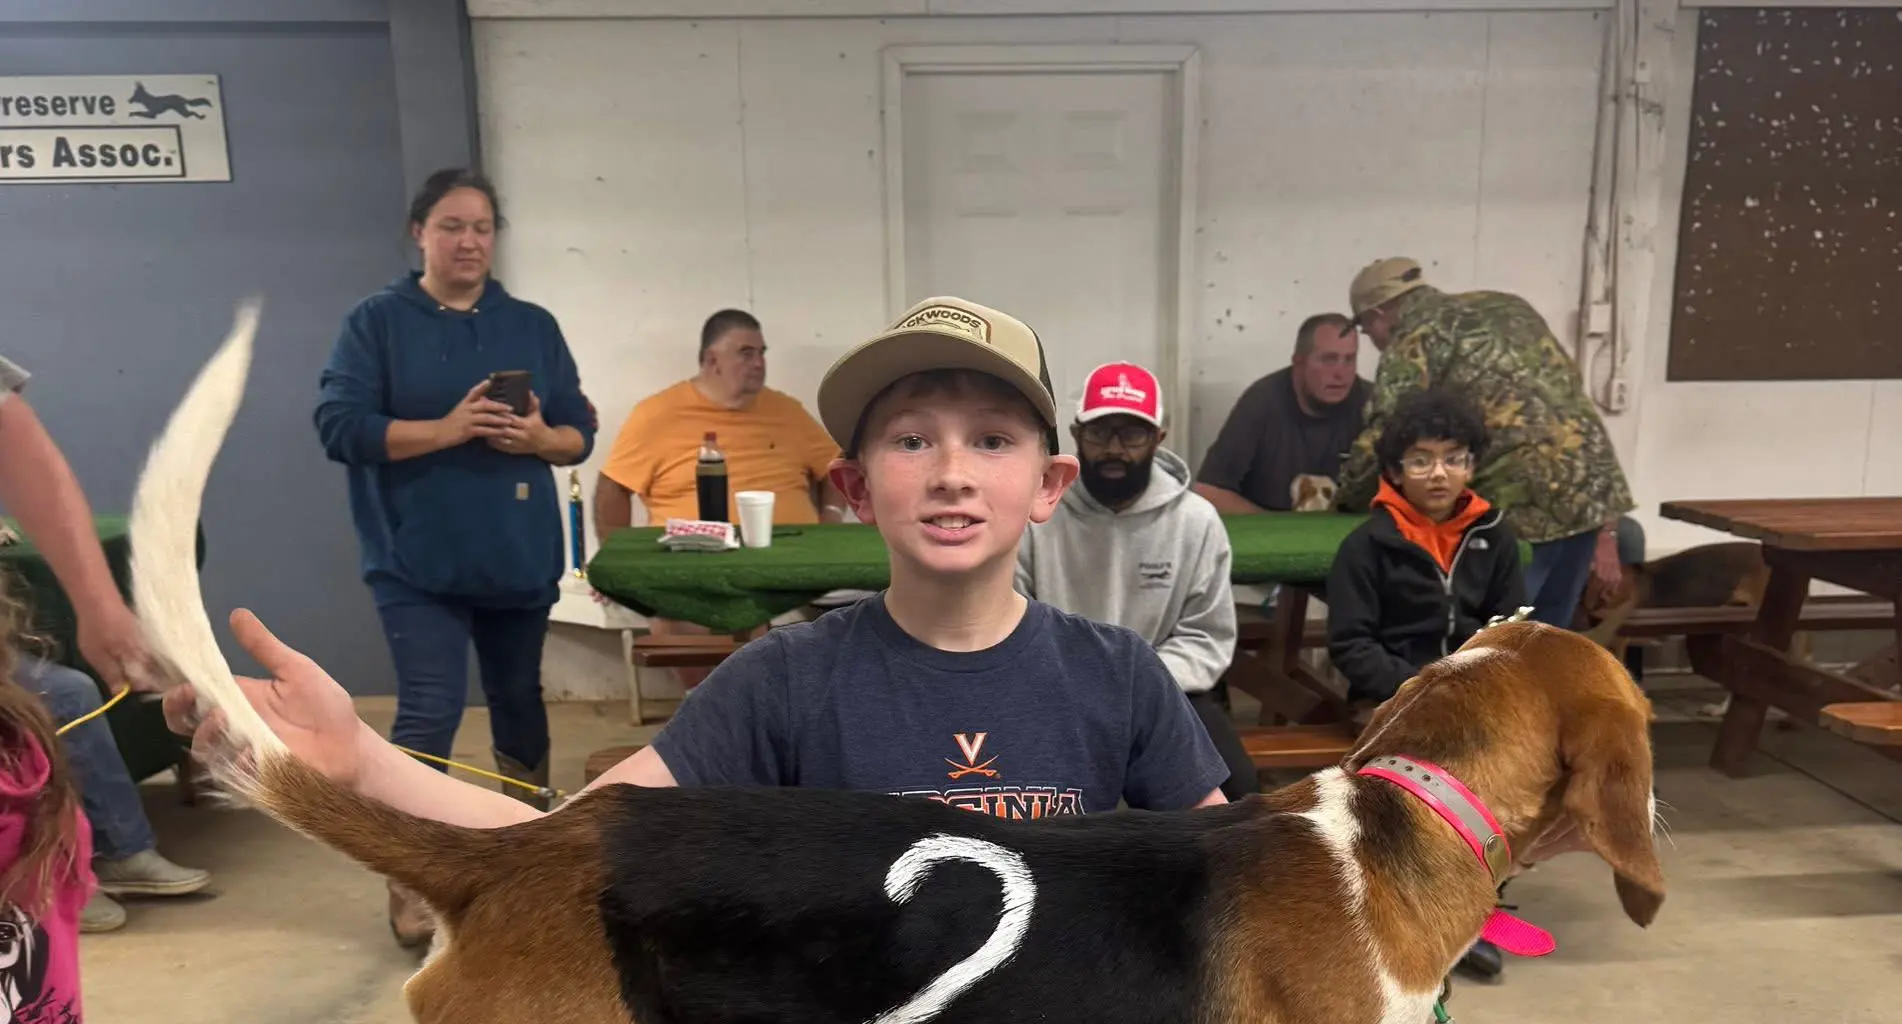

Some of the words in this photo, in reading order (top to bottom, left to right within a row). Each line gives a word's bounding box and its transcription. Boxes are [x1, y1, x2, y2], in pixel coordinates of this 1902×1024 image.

[0, 95, 115, 117] reserve
[53, 136, 173, 168] Assoc.
[902, 310, 982, 329] CKWOODS
